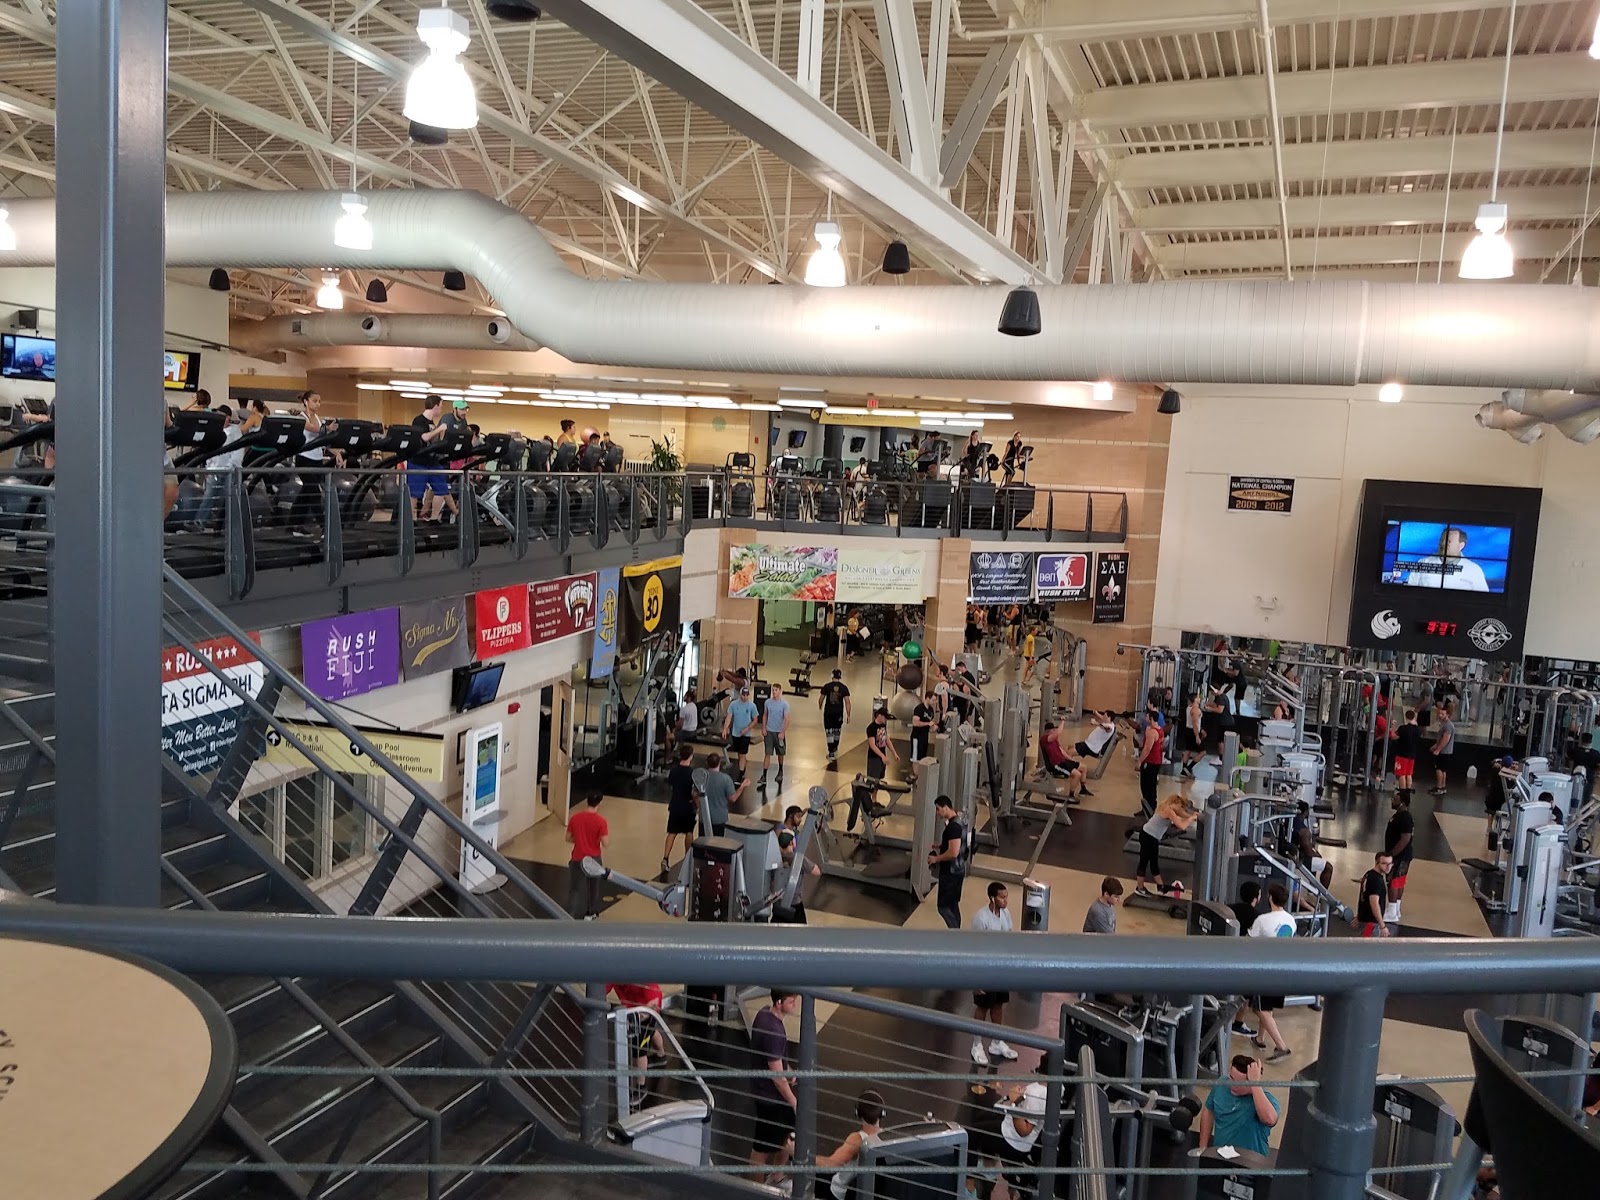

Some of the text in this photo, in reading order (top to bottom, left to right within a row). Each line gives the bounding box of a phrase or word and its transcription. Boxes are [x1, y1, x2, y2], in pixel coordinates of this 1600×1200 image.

[1262, 483, 1292, 491] CHAMPION
[1236, 500, 1284, 511] 2009 2012
[758, 556, 806, 574] Ultimate
[753, 571, 800, 583] Salad
[575, 607, 584, 628] 17
[646, 595, 658, 621] 30
[327, 629, 376, 655] RUSH
[405, 623, 435, 648] Sigma
[326, 649, 375, 681] FIJI
[183, 682, 227, 709] SIGMA
[175, 729, 194, 747] Men
[195, 723, 216, 740] Better
[218, 717, 237, 733] Lives
[384, 743, 400, 752] Pool
[385, 752, 421, 763] Classroom
[399, 763, 433, 774] Adventure
